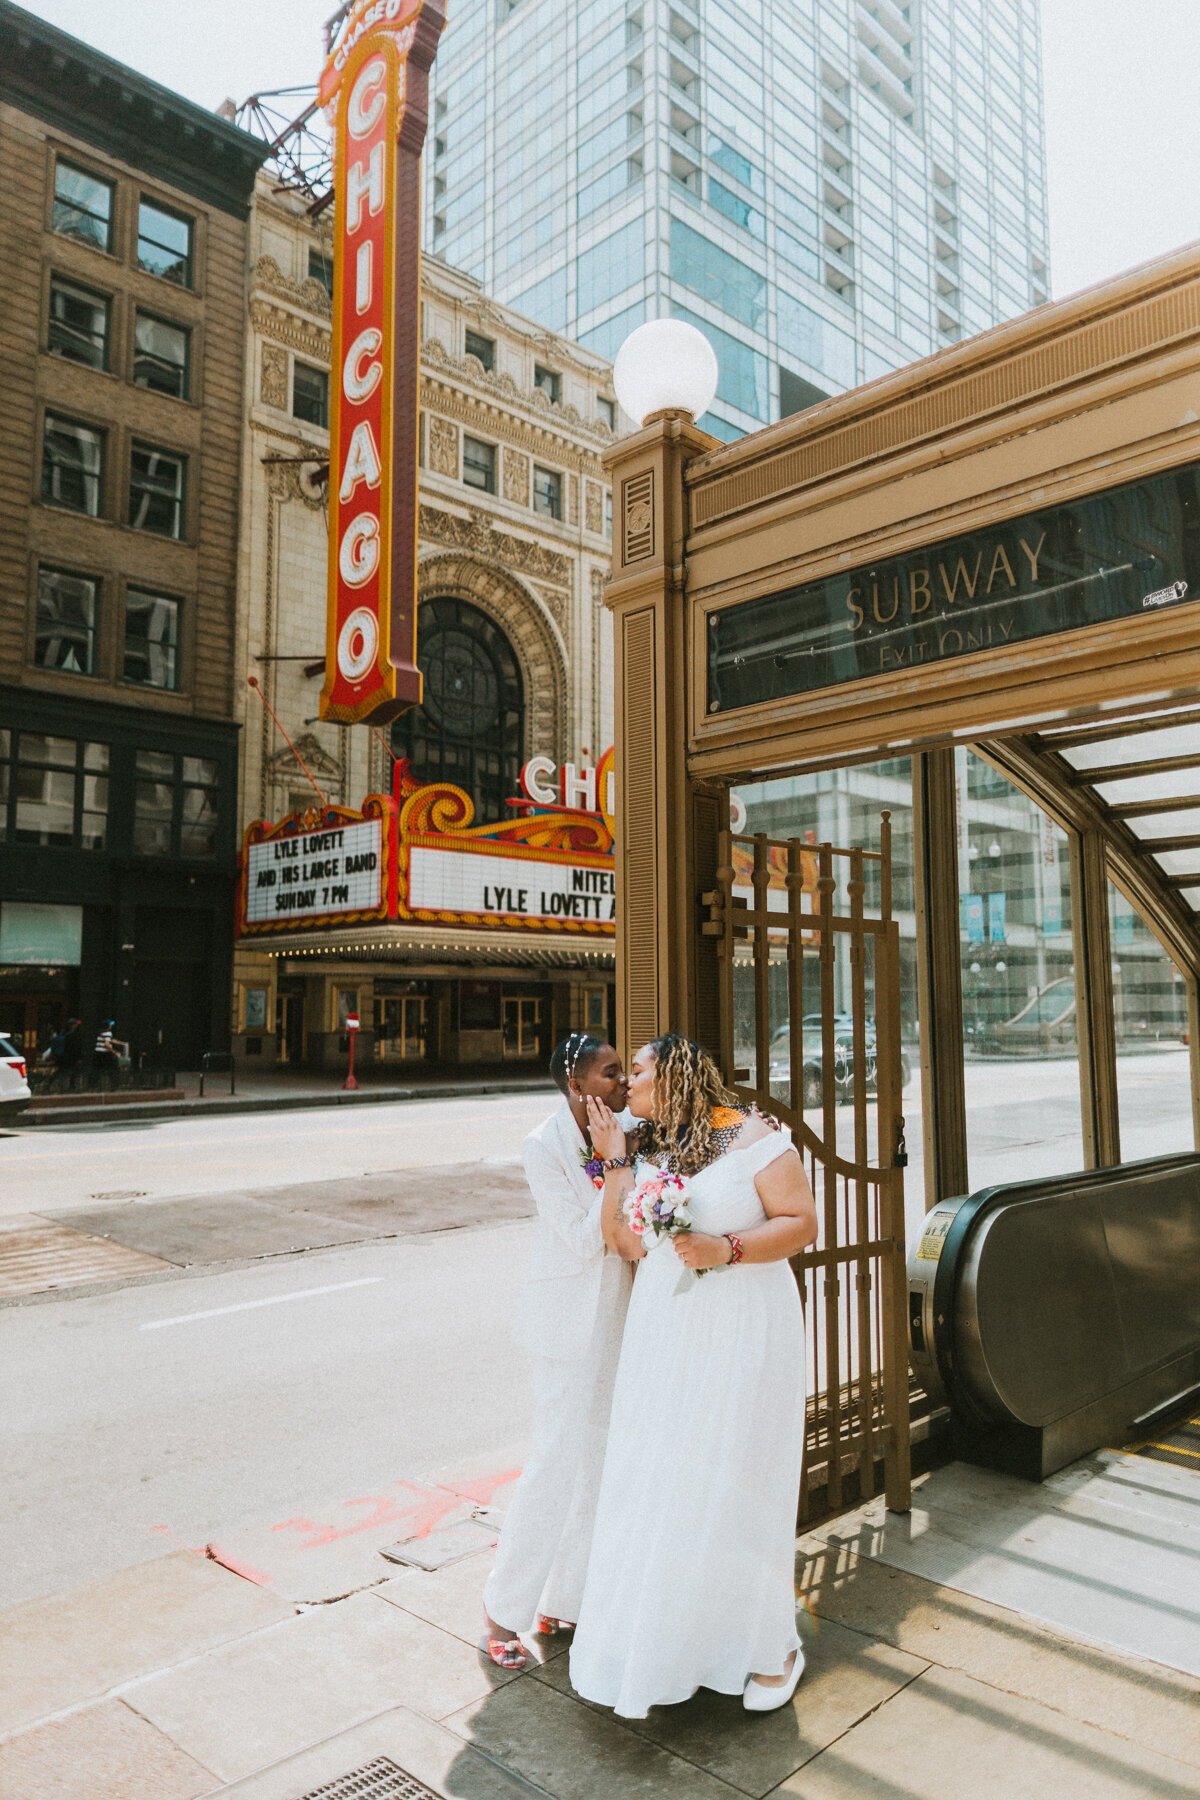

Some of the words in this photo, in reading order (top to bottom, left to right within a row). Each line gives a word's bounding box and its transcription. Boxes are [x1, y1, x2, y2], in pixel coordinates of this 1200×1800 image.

[337, 60, 387, 684] CHICAGO
[846, 531, 1047, 631] SUBWAY
[879, 641, 928, 669] EXIT
[939, 618, 1014, 656] ONLY
[274, 840, 299, 860] LYLE
[303, 830, 344, 855] LOVETT
[257, 869, 277, 888] AND
[282, 865, 300, 884] HIS
[302, 858, 339, 882] LARGE
[345, 852, 377, 875] BAND
[275, 889, 316, 911] SUNDAY
[322, 887, 329, 905] 7
[331, 884, 349, 904] PM
[484, 886, 528, 913] LYLE
[541, 891, 602, 919] LOVETT
